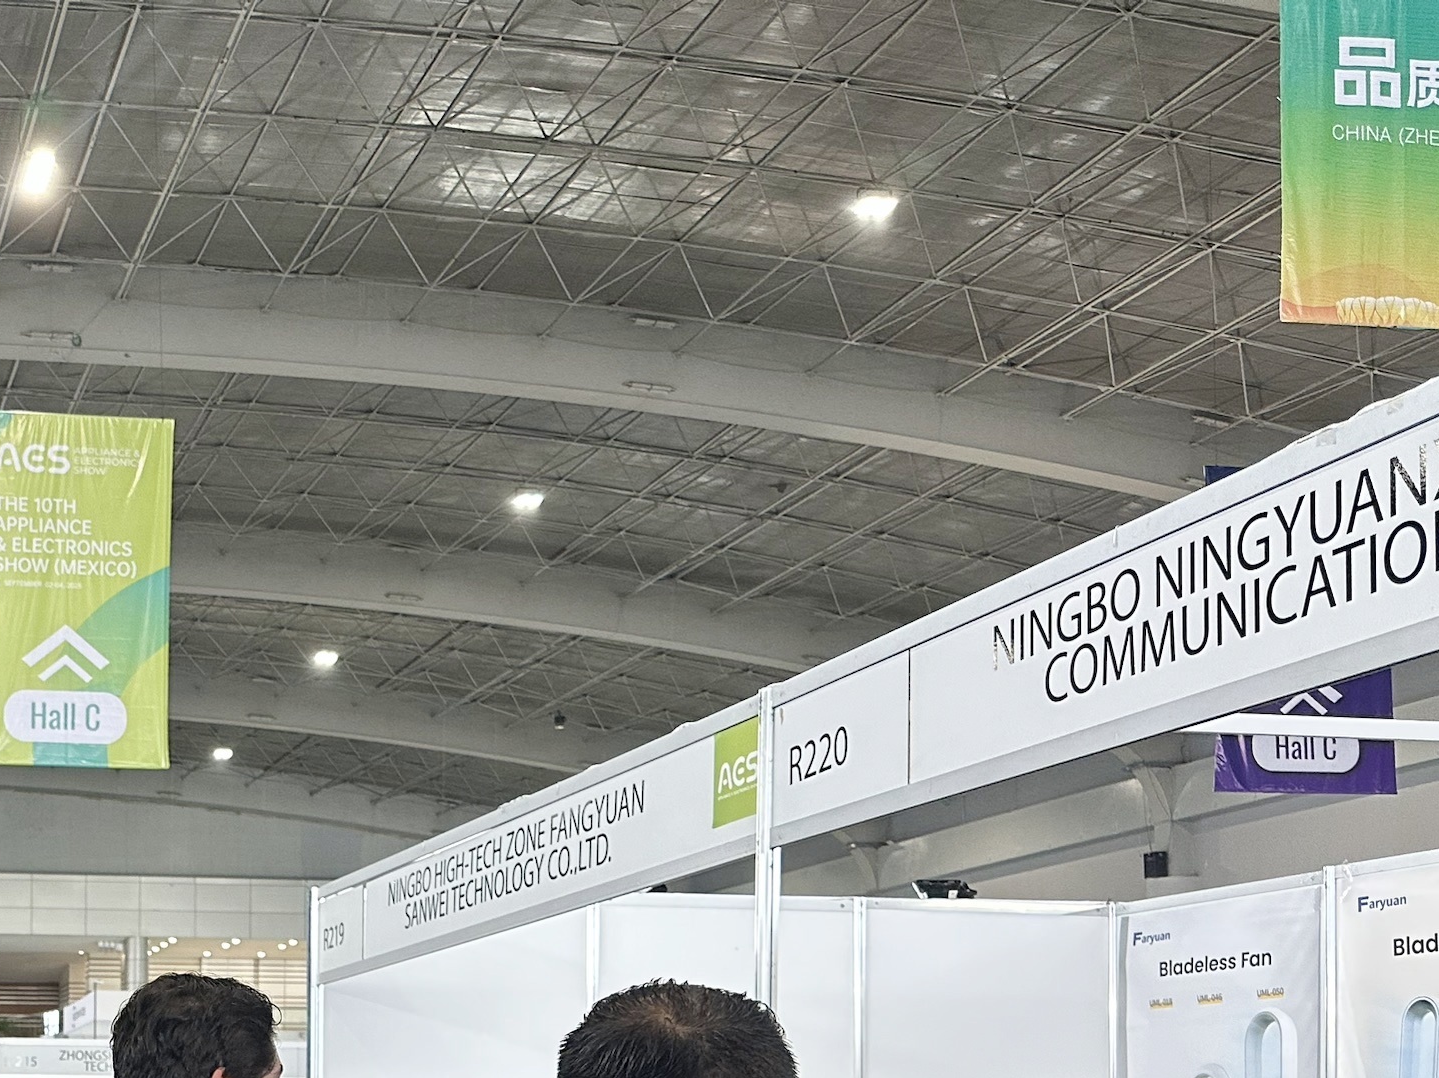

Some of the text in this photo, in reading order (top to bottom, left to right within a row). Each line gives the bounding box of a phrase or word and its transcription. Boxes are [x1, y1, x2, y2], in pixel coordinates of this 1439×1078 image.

[1332, 124, 1392, 143] CHINA
[74, 457, 142, 468] ELECTRONIC
[34, 497, 76, 514] 10TH
[11, 537, 133, 557] ELECTRONICS
[993, 438, 1439, 671] NINGBO NINGYUAN
[54, 558, 137, 579] (MEXICO)
[1045, 510, 1439, 703] COMMUNICATIO
[31, 702, 100, 731] Hall C
[789, 726, 848, 785] R220
[1275, 735, 1336, 760] Hall C
[388, 780, 645, 906] NINGBO HIGH-TECH ZONE FANGYUAN
[405, 833, 612, 929] SANWEI TECHNOLOGY CO.,LTD.
[1357, 896, 1407, 912] Faryuan
[323, 922, 345, 950] R219
[1133, 932, 1171, 946] Faryuan
[1393, 933, 1439, 956] Blad
[1159, 952, 1272, 977] Bladeless Fan
[59, 1050, 112, 1061] ZHONGS
